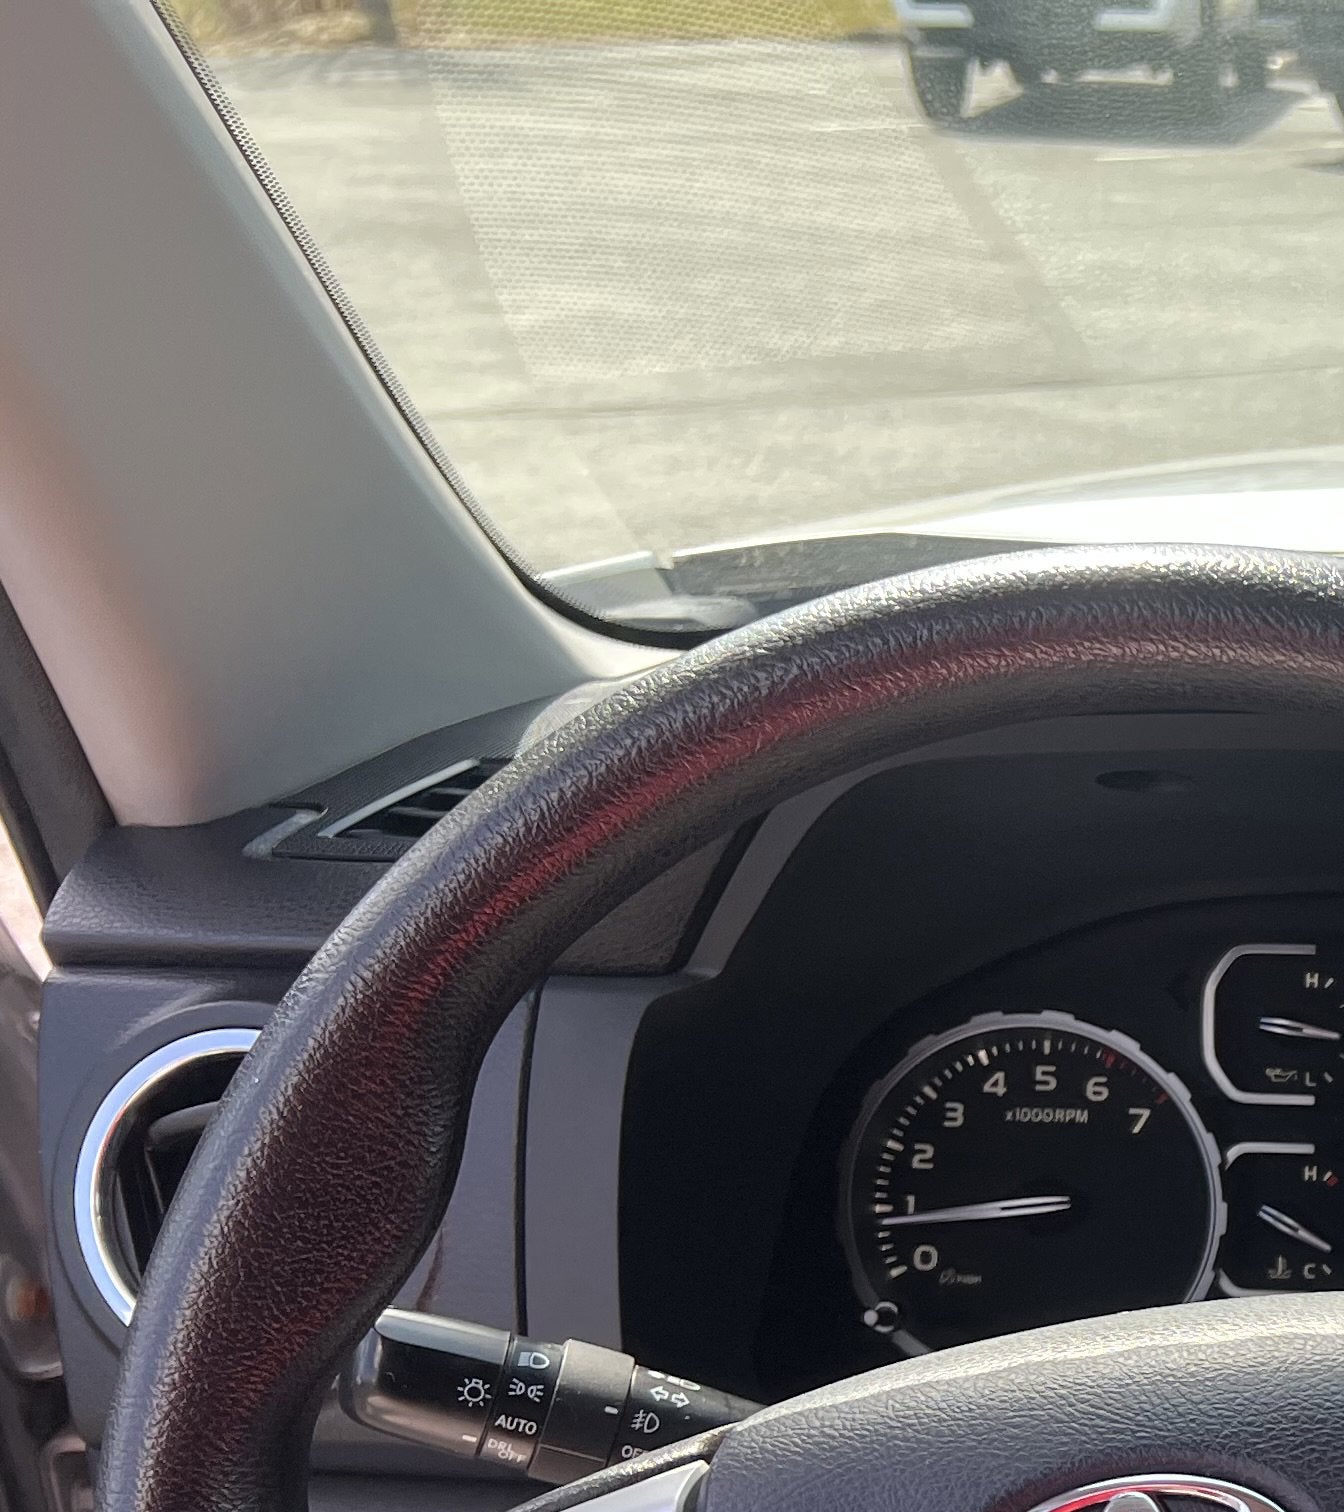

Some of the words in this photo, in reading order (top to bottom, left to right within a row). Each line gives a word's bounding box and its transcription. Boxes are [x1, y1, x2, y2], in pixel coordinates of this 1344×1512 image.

[1305, 972, 1319, 988] H
[983, 1072, 1007, 1097] 4
[1035, 1065, 1057, 1091] 5
[1086, 1076, 1109, 1101] 6
[1305, 1071, 1317, 1087] L
[943, 1102, 965, 1128] 3
[1128, 1107, 1151, 1134] 7
[912, 1143, 935, 1169] 2
[1304, 1166, 1317, 1182] H
[906, 1195, 916, 1215] 1
[913, 1245, 938, 1271] 0
[1304, 1263, 1316, 1279] C
[494, 1414, 537, 1435] AUTO
[497, 1450, 528, 1463] OFF
